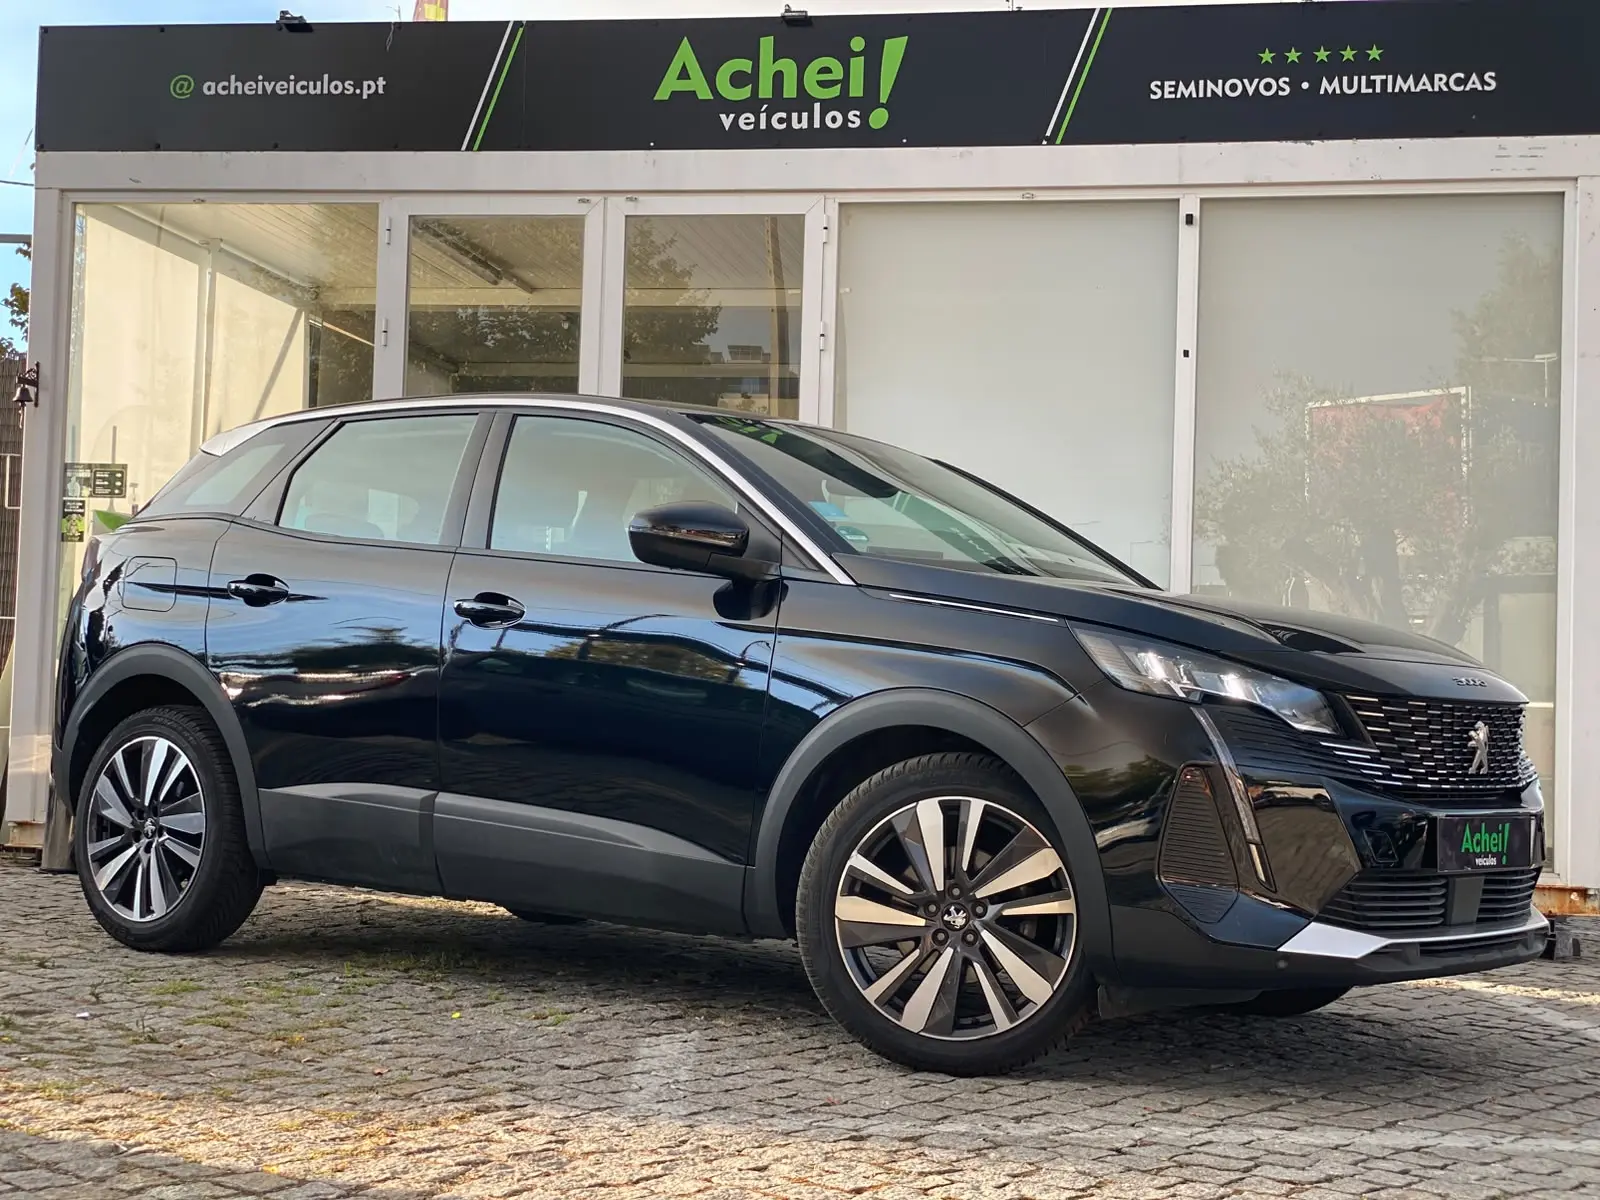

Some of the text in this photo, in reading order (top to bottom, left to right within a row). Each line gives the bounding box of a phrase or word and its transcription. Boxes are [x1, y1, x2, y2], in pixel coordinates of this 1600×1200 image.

[202, 73, 386, 99] acheiveiculos.pt
[653, 35, 909, 129] Achei!
[1149, 71, 1497, 100] SEMINOVOS MULTIMARCAS
[719, 102, 861, 131] veículos
[1461, 822, 1511, 865] Achei!
